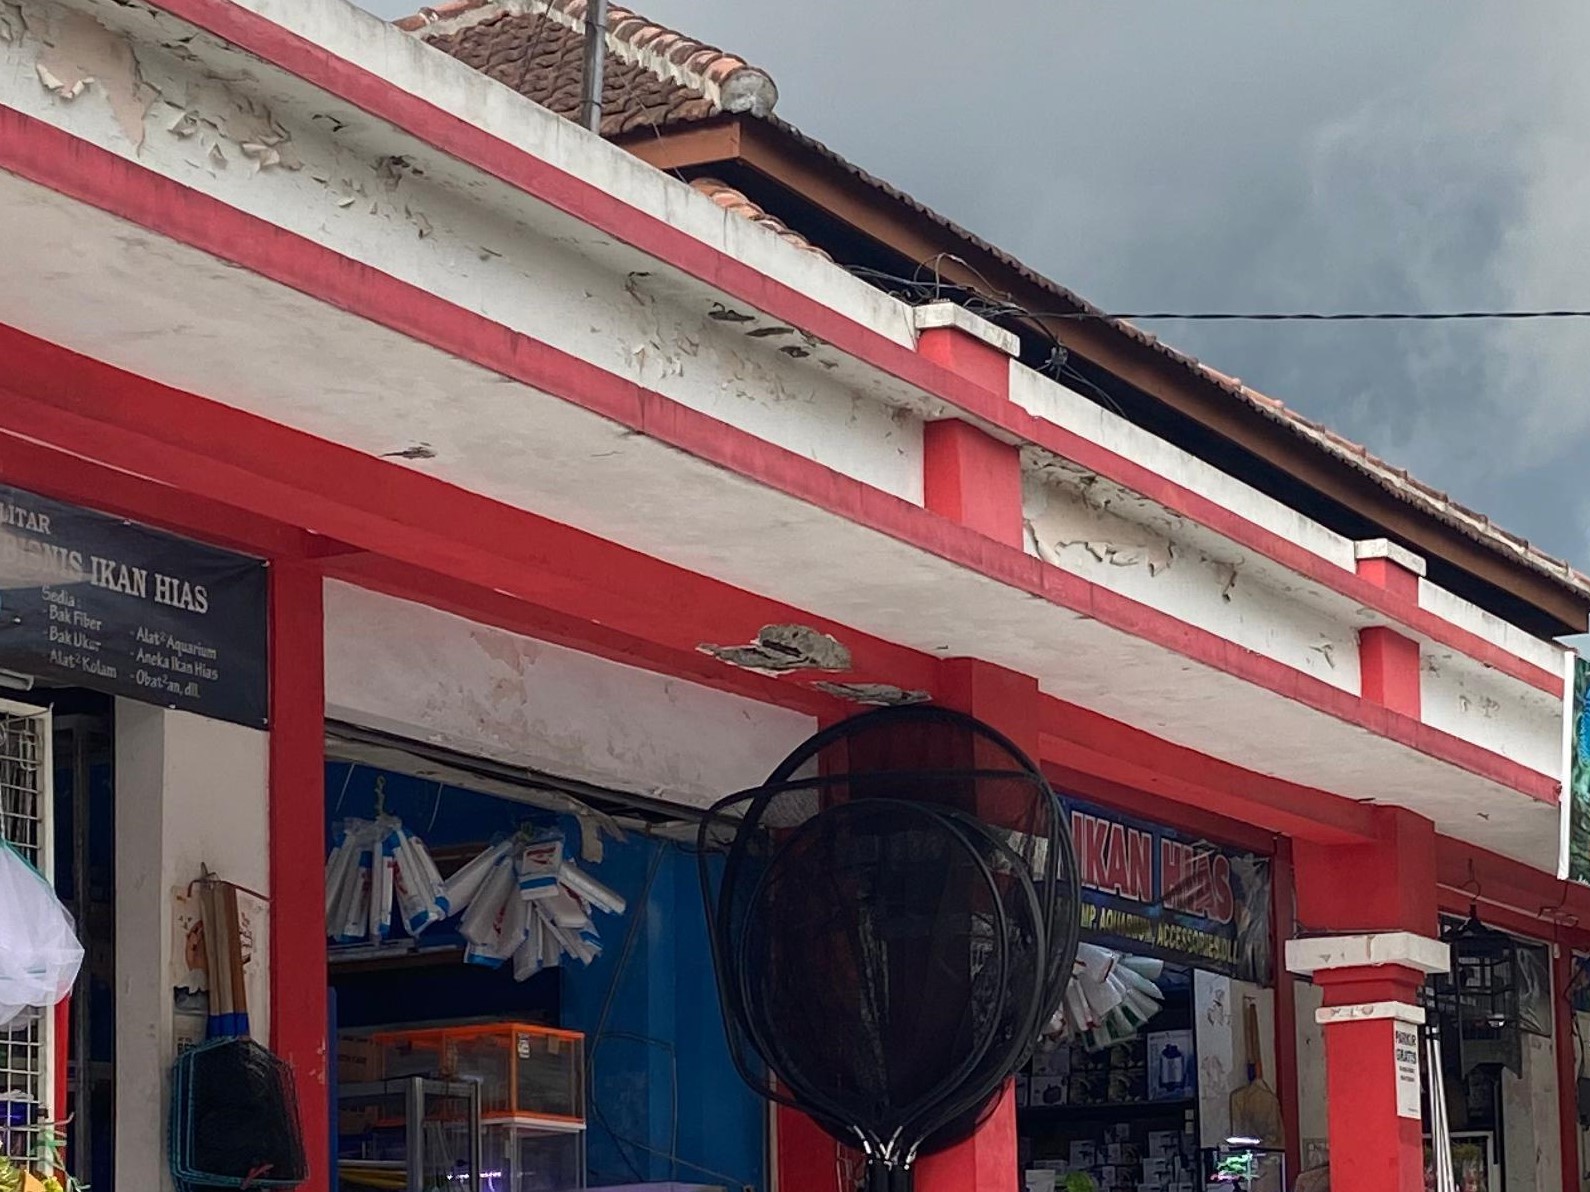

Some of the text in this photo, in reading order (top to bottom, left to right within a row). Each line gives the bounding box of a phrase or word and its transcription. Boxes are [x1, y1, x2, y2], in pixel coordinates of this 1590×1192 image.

[90, 555, 148, 599] IKAN
[154, 572, 209, 614] HIAS
[49, 604, 103, 632] Bak Fiber
[49, 625, 72, 646] Bak
[166, 634, 217, 660] Aquarium
[82, 656, 117, 679] Kolam
[136, 647, 219, 682] Aneka Ikan Hias
[1072, 809, 1234, 926] IKAN HIAS
